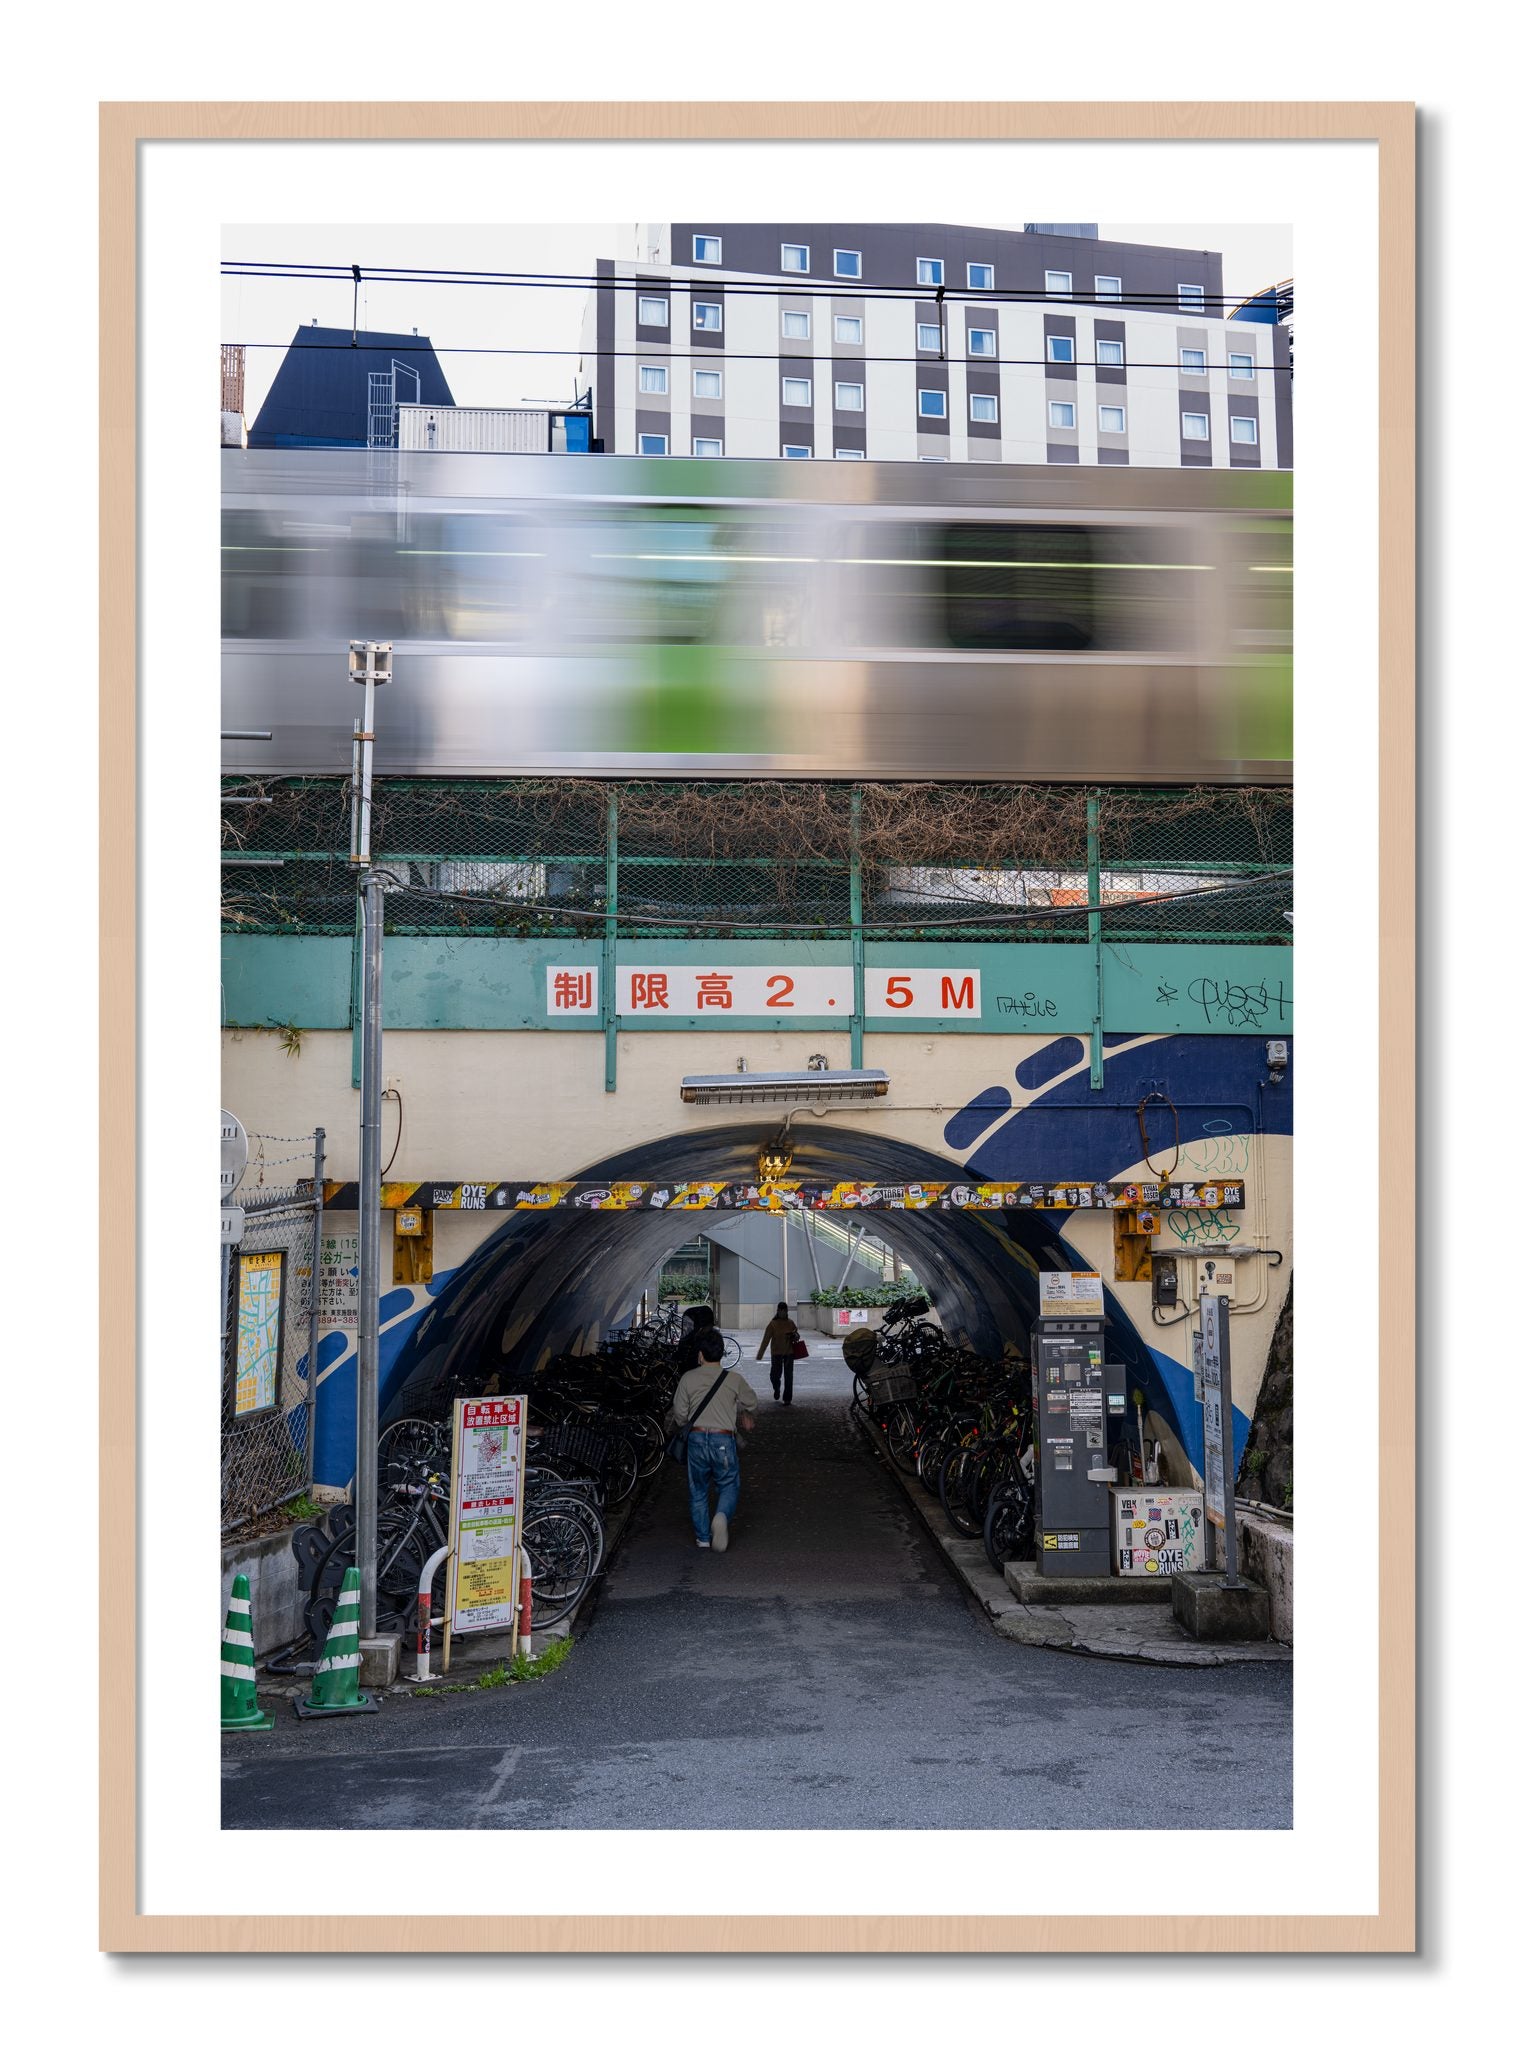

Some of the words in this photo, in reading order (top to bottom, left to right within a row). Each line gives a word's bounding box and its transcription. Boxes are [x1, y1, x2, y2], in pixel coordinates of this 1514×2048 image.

[461, 1184, 487, 1198] OYE
[1224, 1186, 1240, 1195] OYE
[460, 1196, 486, 1210] RUNS
[1158, 1549, 1183, 1562] OYE
[1159, 1561, 1184, 1575] RUNS
